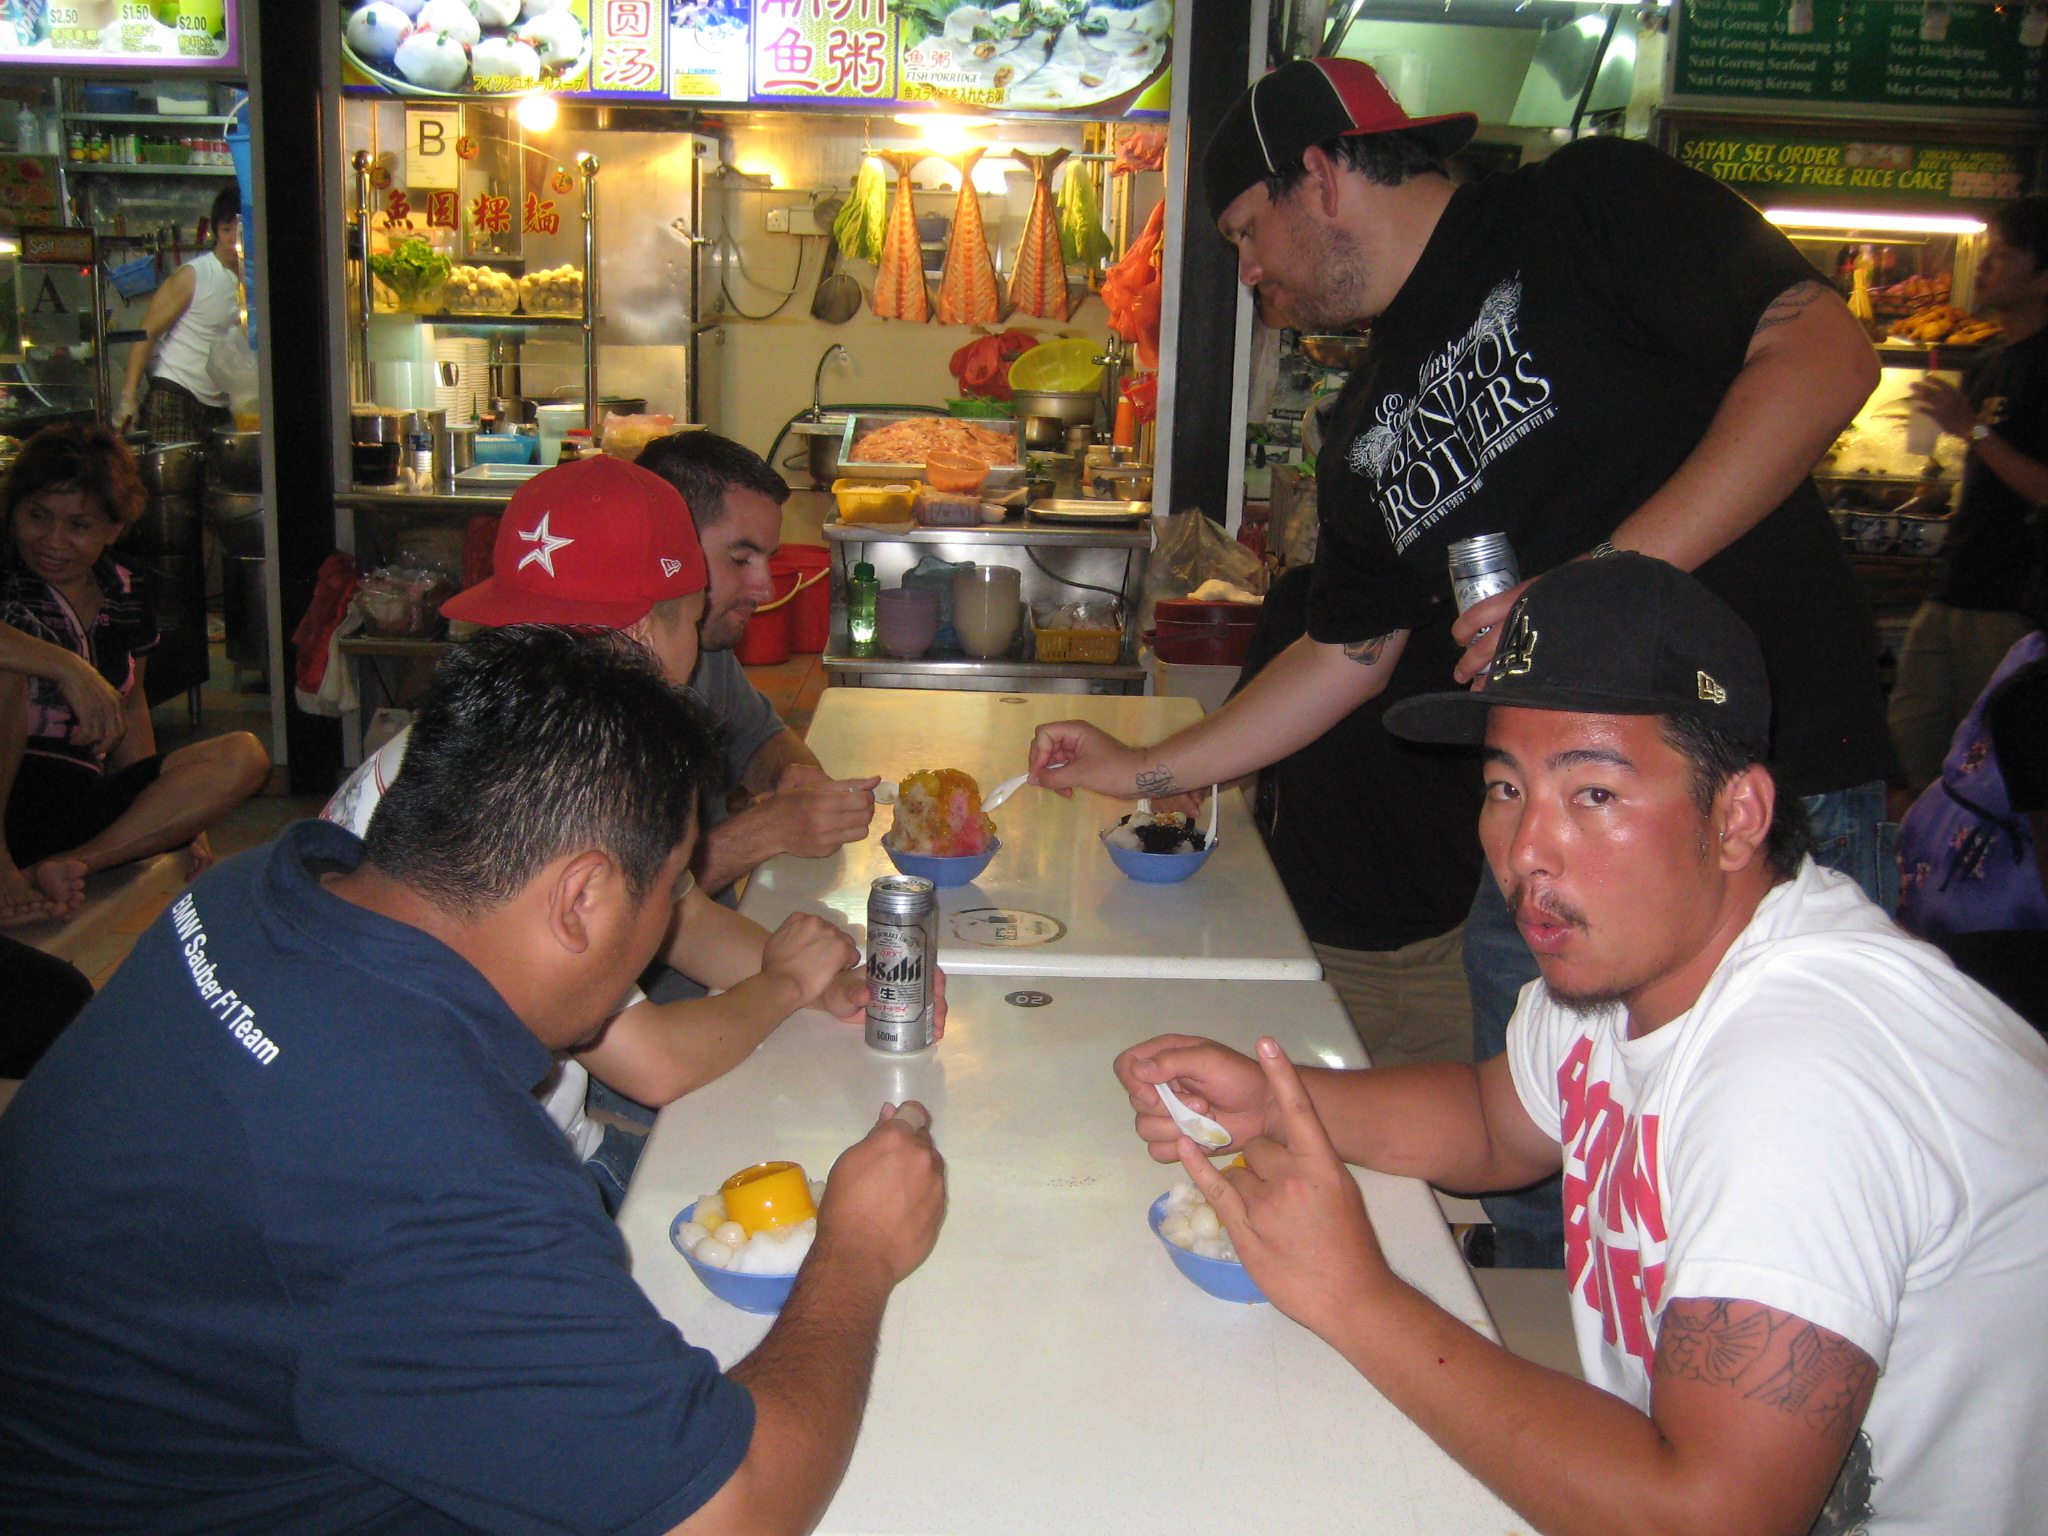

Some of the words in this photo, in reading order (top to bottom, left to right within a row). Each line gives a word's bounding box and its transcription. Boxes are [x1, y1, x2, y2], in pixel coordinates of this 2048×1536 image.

[50, 8, 78, 24] $2.50
[122, 4, 149, 20] $1.50
[179, 15, 207, 31] $2.00
[763, 27, 886, 93] 鱼粥
[906, 49, 951, 69] 鱼粥
[905, 72, 929, 82] FISH
[930, 72, 979, 83] PORRIDGE
[419, 120, 446, 156] B
[1681, 140, 1742, 161] SATAY
[1742, 143, 1777, 163] SET
[1777, 145, 1841, 166] ORDER
[1800, 165, 1848, 186] FREE
[1850, 168, 1897, 188] RICE
[1897, 170, 1949, 190] CAKE
[32, 273, 70, 313] A
[1515, 422, 1531, 438] YOU
[172, 892, 203, 941] BMW
[184, 933, 223, 1000] Sauber
[866, 953, 922, 983] Asahi
[210, 989, 242, 1021] F1
[880, 987, 896, 1000] 生
[228, 1004, 280, 1065] Team
[876, 1030, 899, 1042] 500ml
